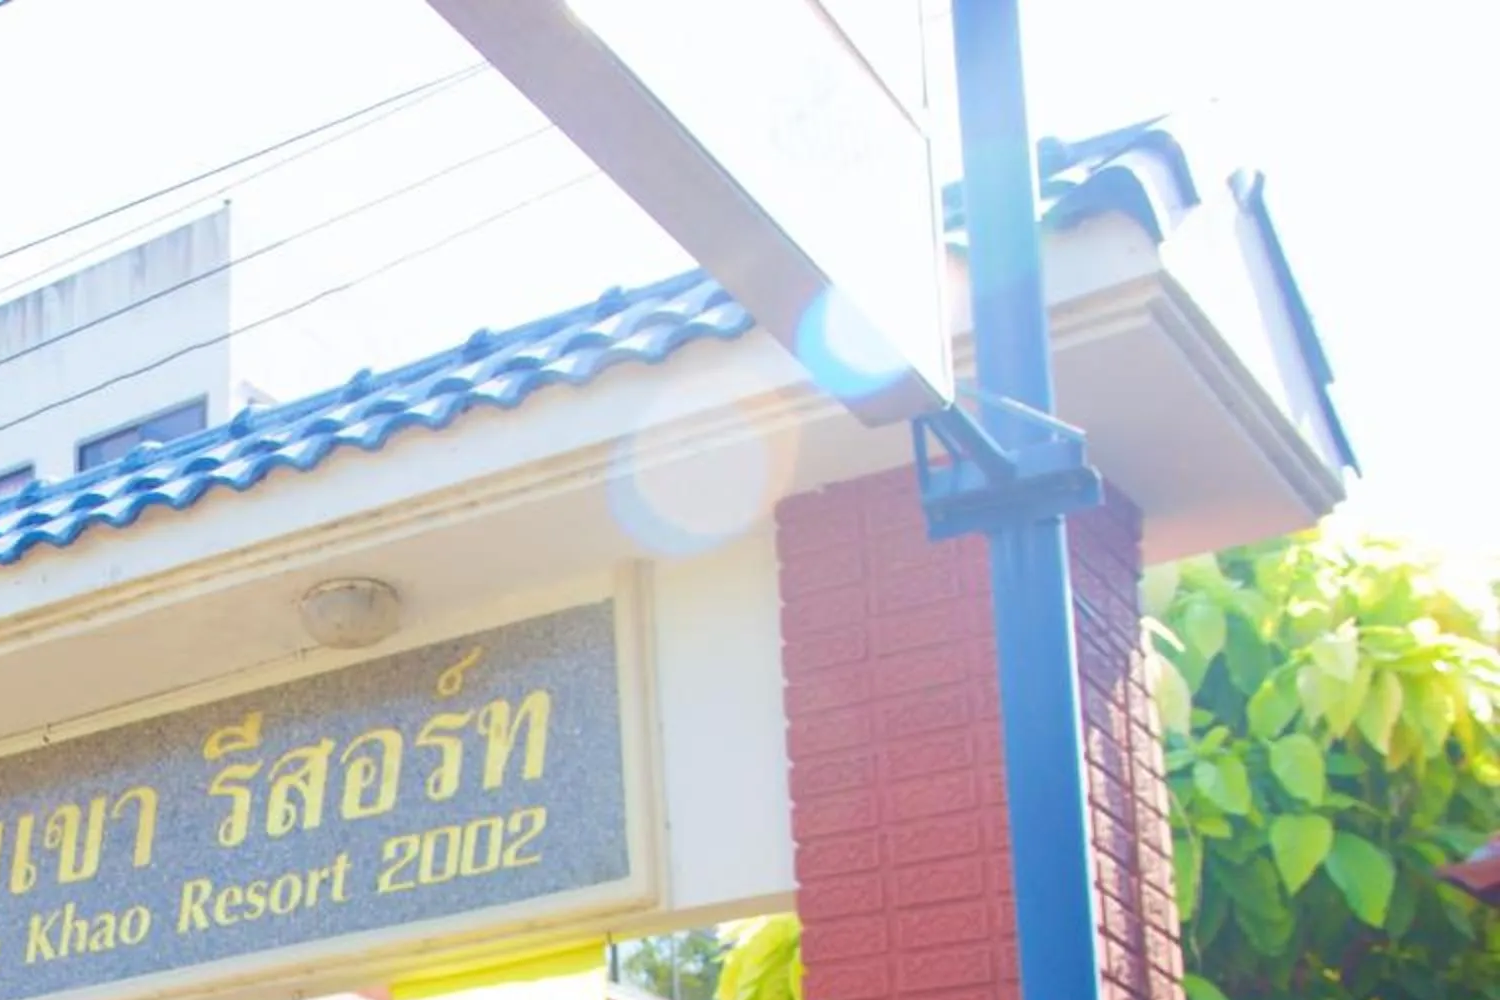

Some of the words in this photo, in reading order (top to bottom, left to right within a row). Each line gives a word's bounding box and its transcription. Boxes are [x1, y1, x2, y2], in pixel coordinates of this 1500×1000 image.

[203, 646, 550, 848] รีสอร์ท
[25, 902, 151, 964] Khao
[176, 851, 351, 934] Resort
[377, 807, 547, 893] 2002
